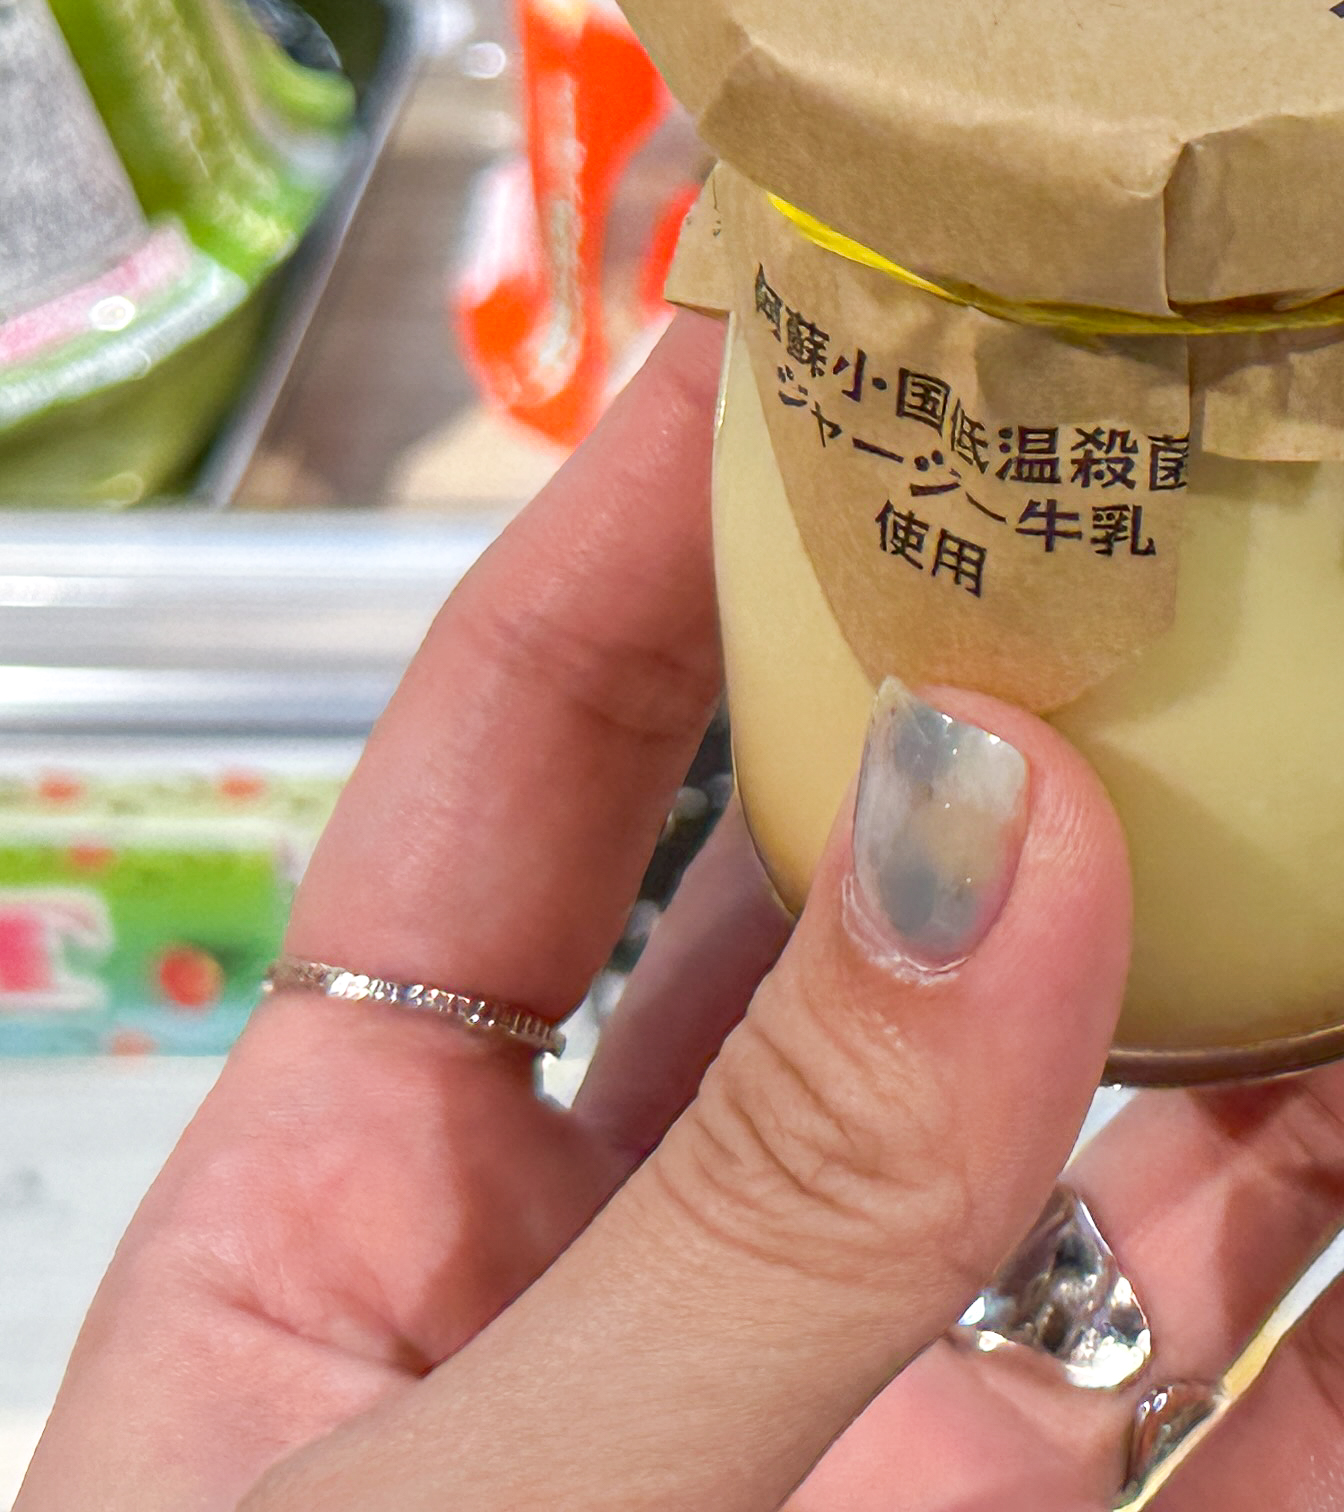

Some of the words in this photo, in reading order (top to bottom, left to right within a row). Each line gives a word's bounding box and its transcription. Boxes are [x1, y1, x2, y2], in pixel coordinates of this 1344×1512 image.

[776, 364, 1157, 558] ジャージー牛乳
[874, 499, 988, 599] 使用
